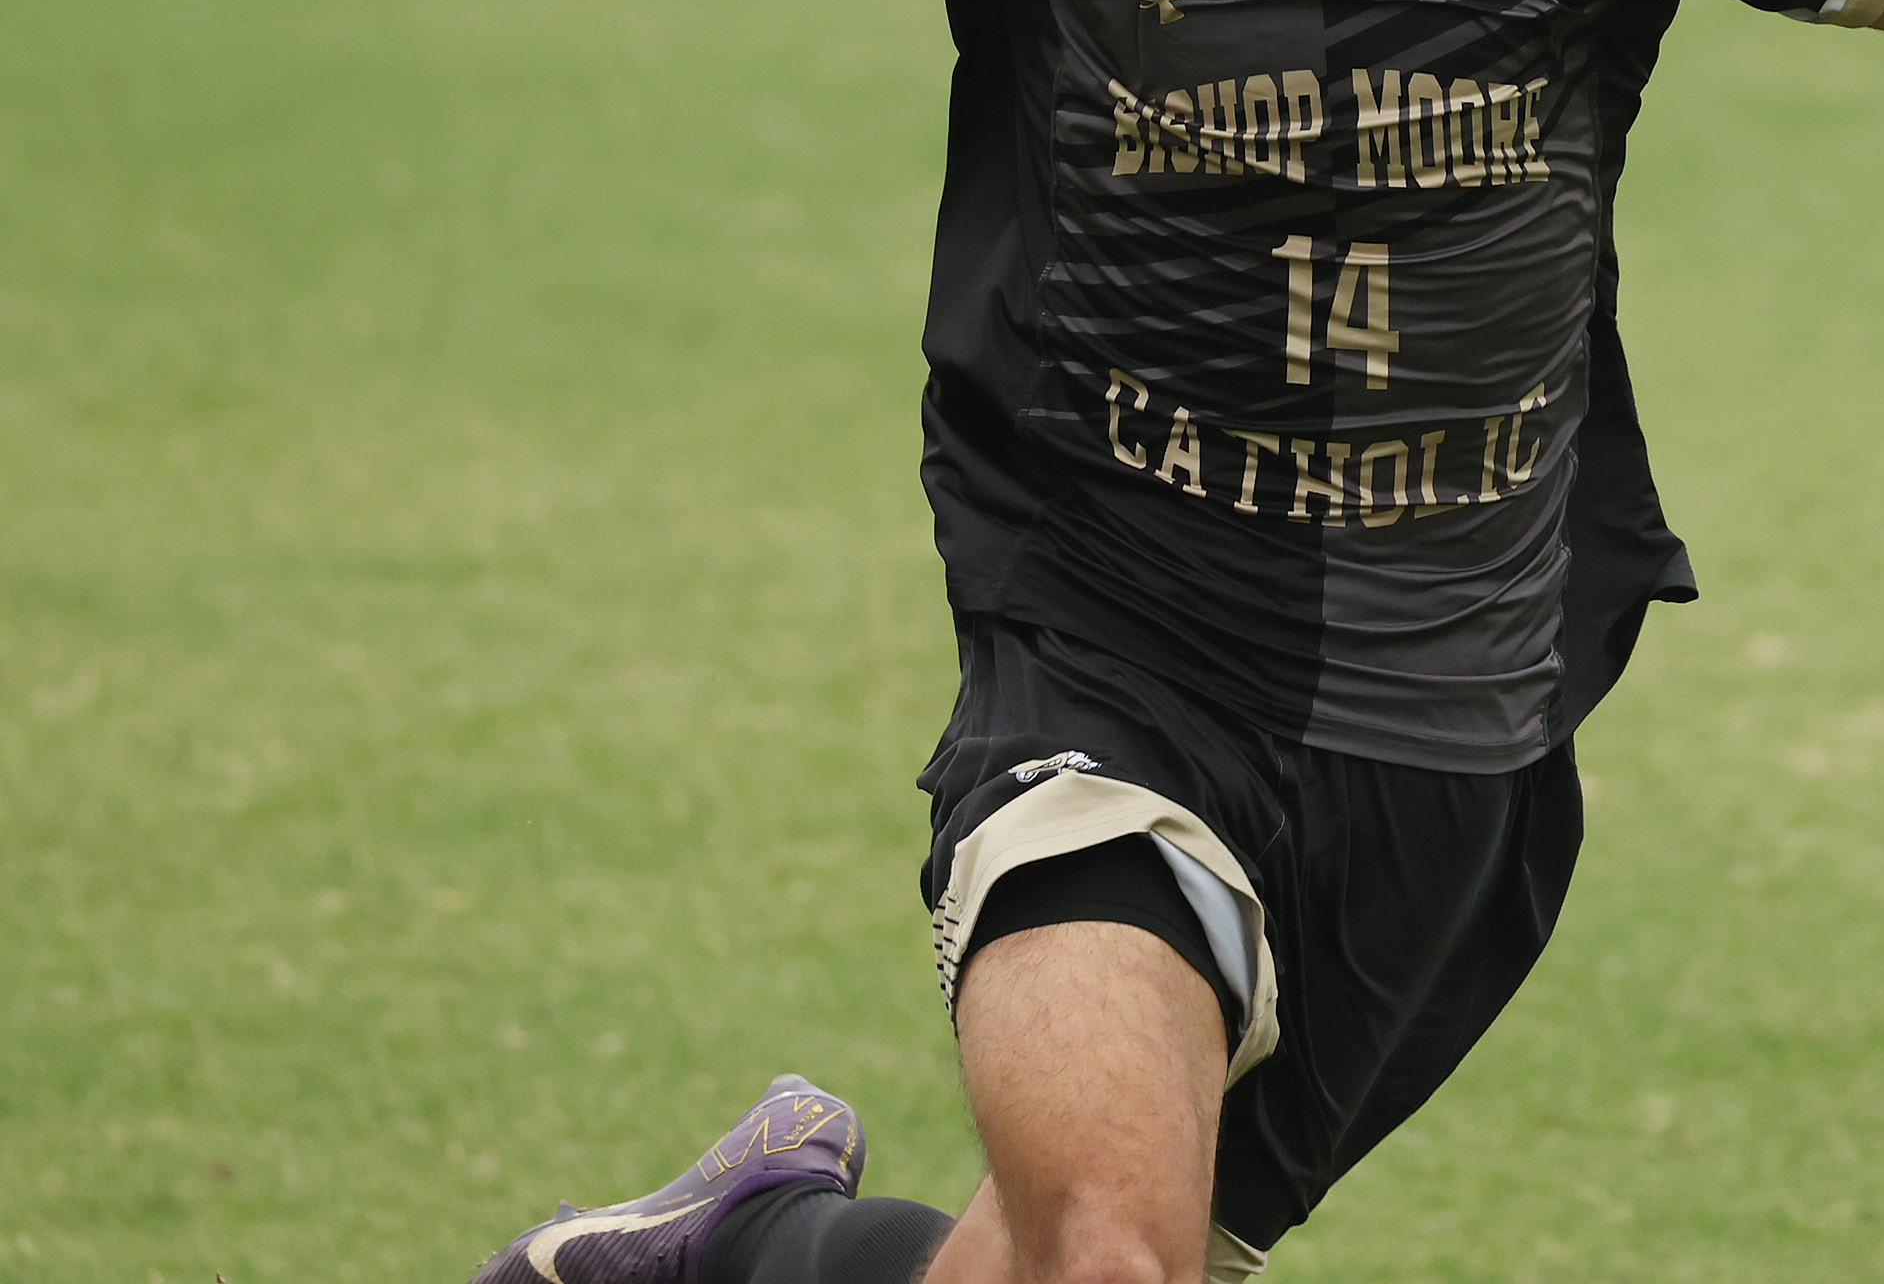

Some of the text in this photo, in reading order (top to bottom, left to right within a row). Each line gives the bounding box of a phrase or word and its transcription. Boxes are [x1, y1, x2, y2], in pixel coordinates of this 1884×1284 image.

[1107, 68, 1551, 189] BISHOP MOORE
[1271, 234, 1400, 391] 14
[1104, 367, 1548, 529] CATHOLIC
